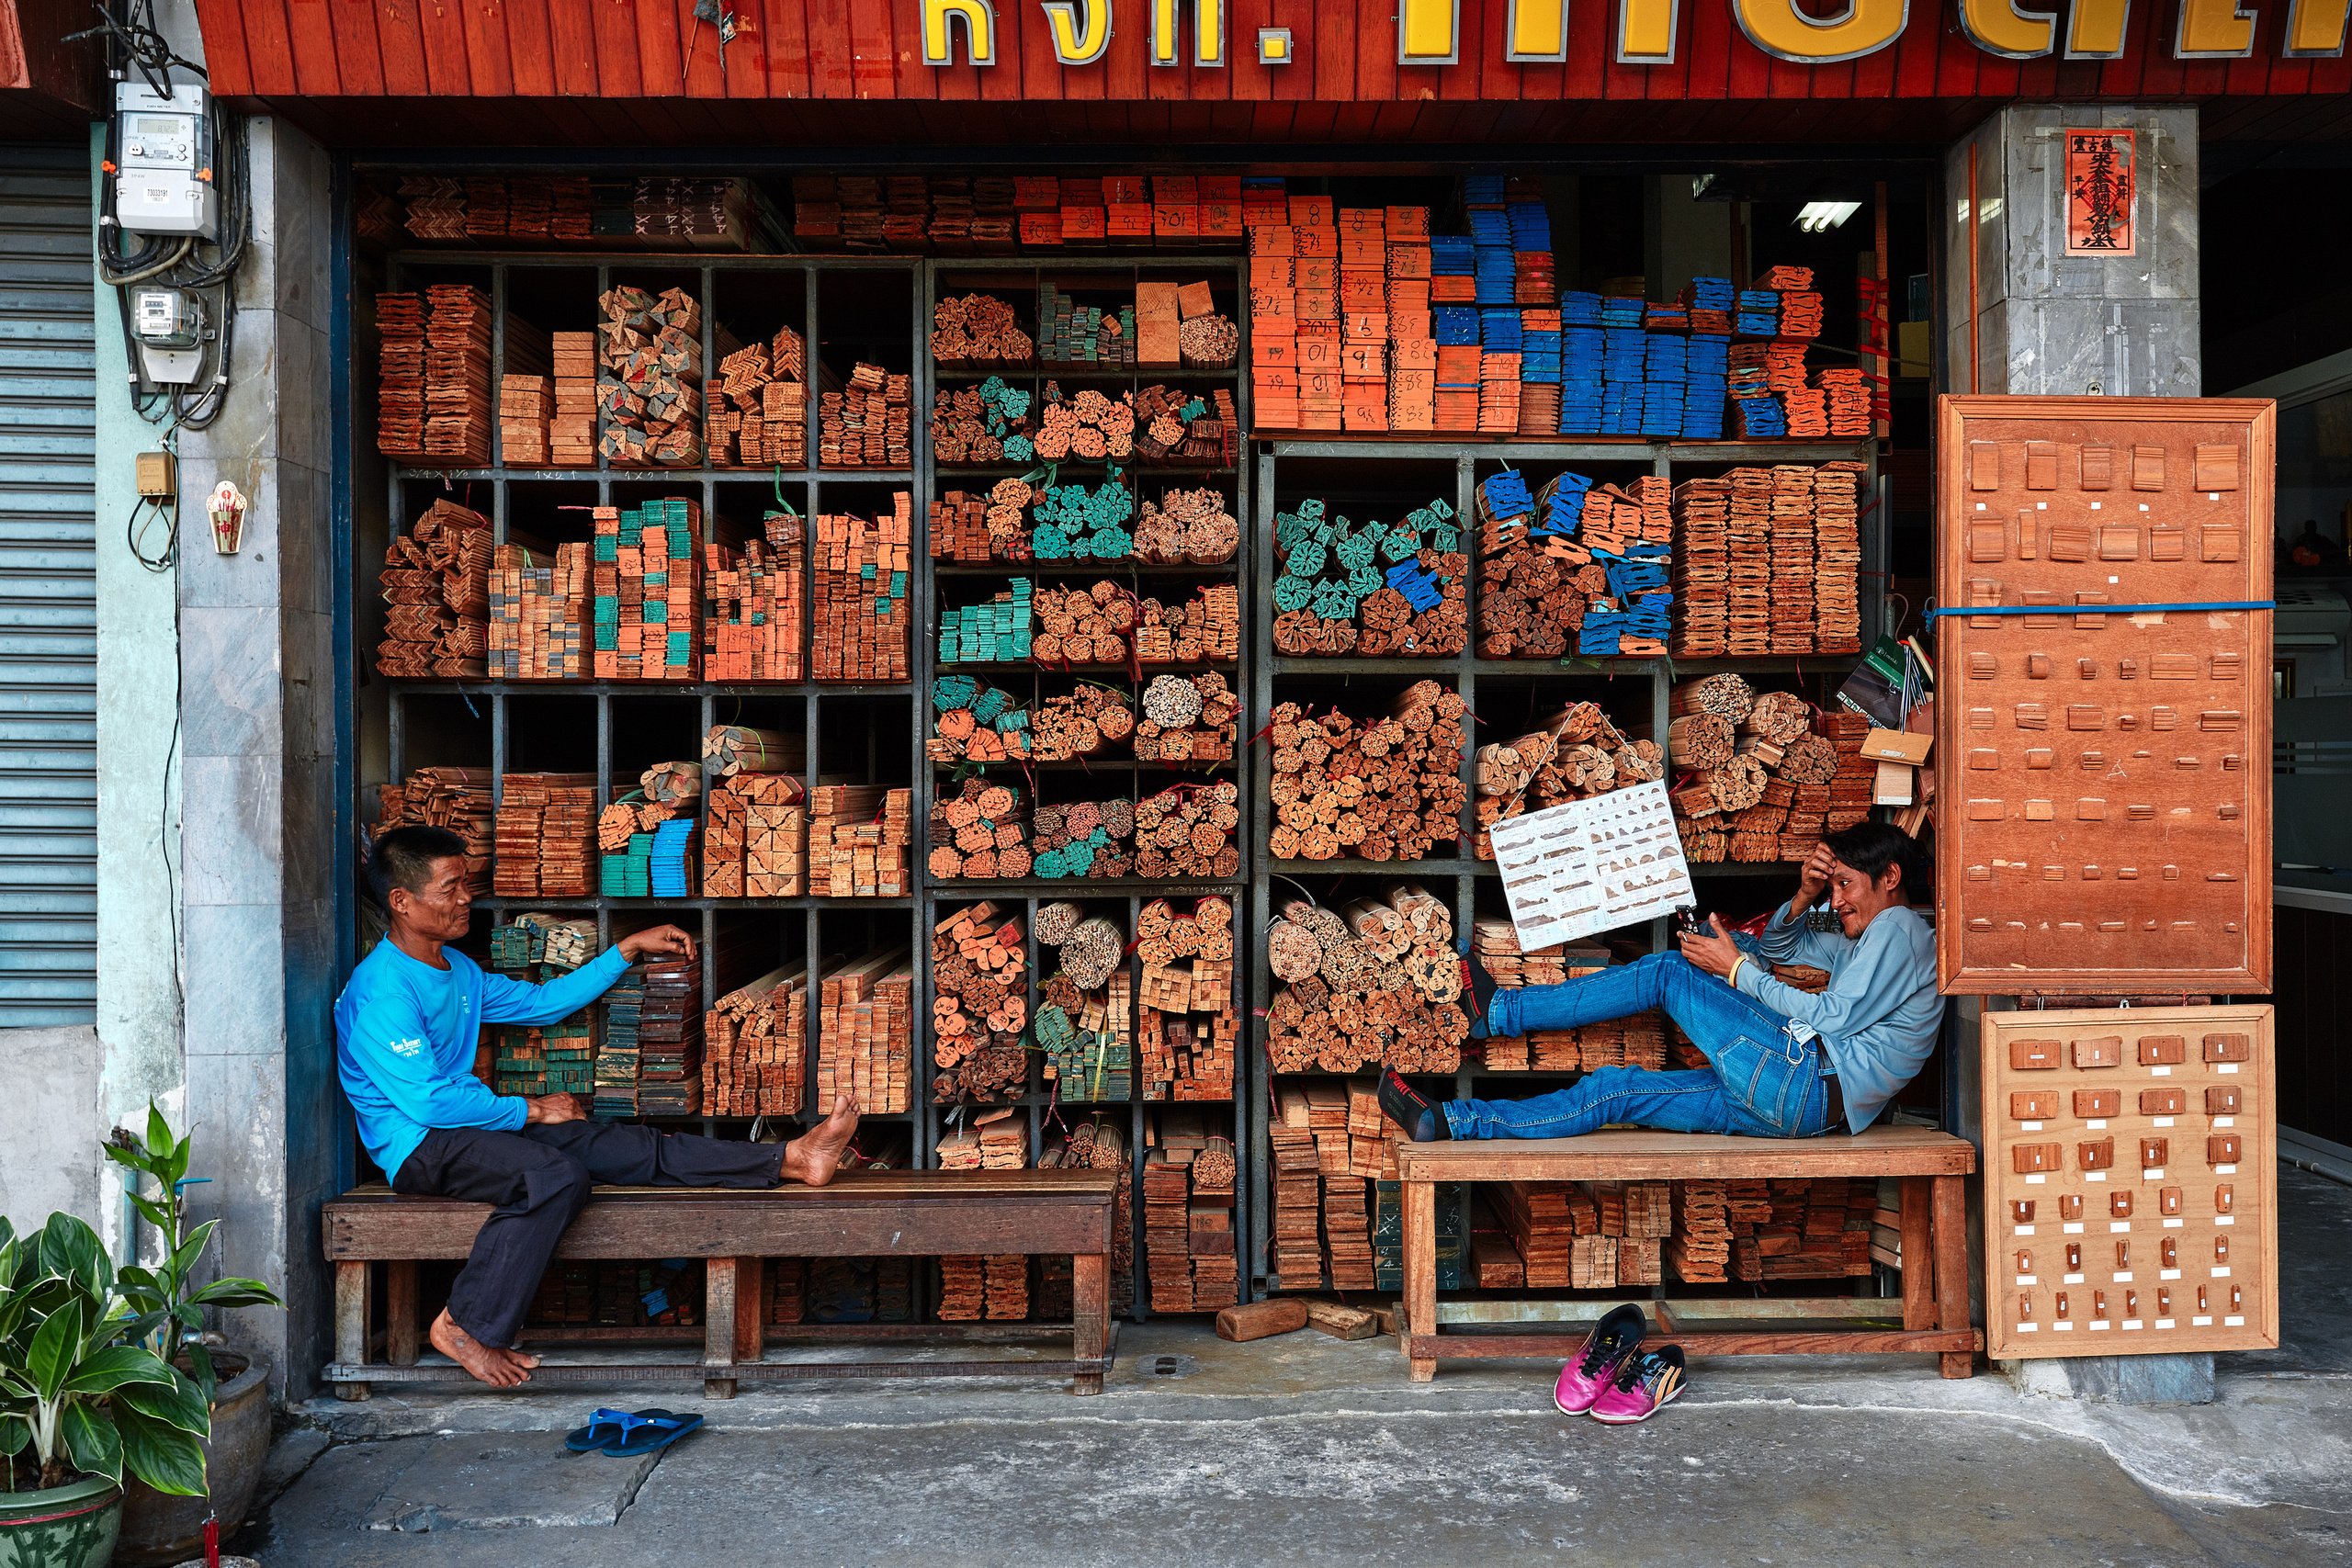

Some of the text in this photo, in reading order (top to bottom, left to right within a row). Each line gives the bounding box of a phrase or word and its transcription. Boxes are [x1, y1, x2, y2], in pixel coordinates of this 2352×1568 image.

[147, 188, 168, 197] 73033191
[1308, 204, 1320, 226] 8
[1351, 210, 1365, 231] 8
[1355, 242, 1363, 257] 7
[216, 520, 232, 540] 神
[1460, 959, 1475, 990] SPORT
[1387, 1070, 1412, 1096] SPORT
[1195, 1215, 1214, 1228] 180
